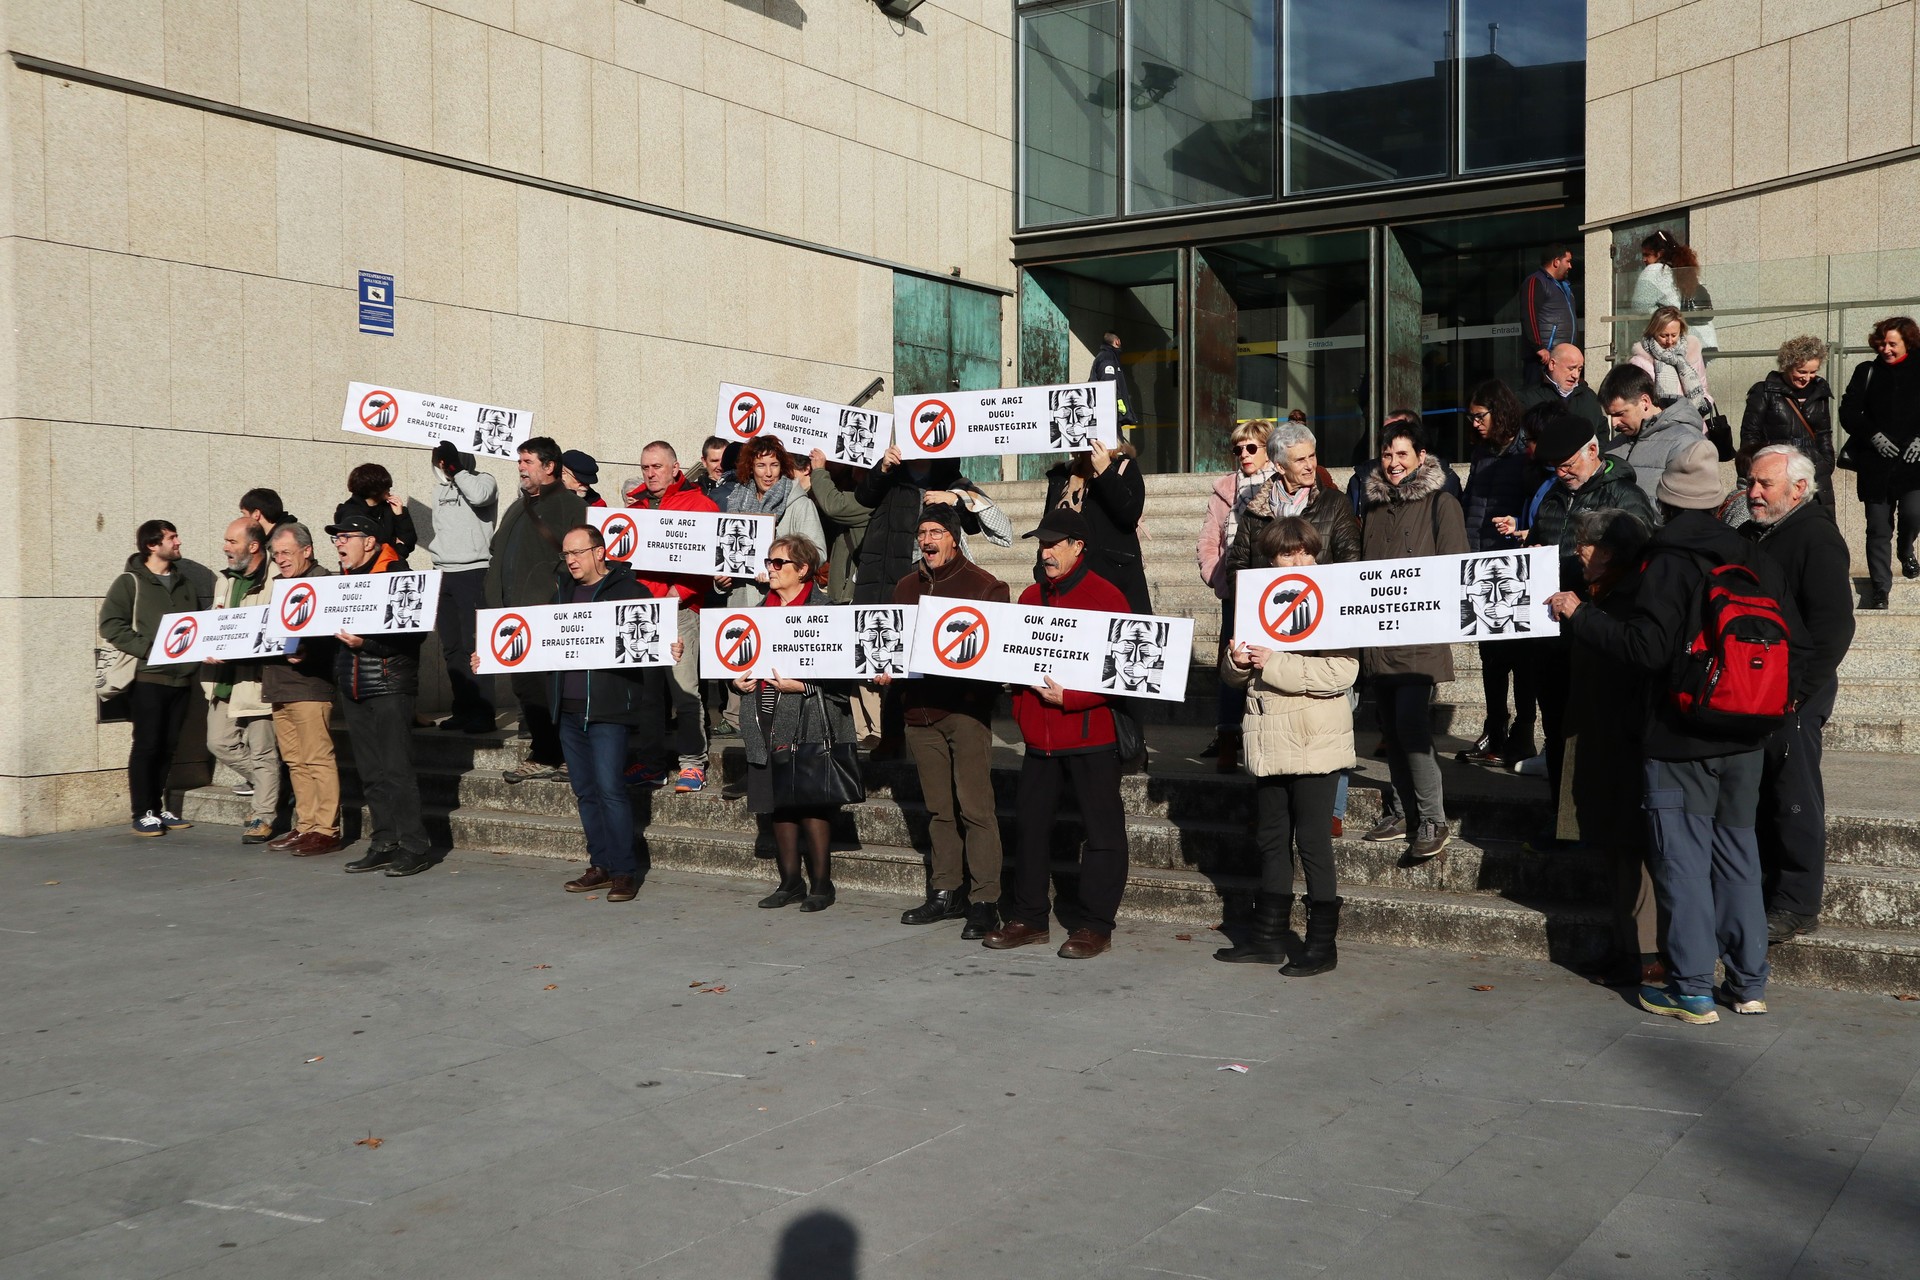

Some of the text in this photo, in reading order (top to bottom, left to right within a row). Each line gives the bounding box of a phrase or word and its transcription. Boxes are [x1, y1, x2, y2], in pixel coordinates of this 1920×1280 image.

[1490, 325, 1520, 335] Entrada
[1307, 340, 1334, 348] Entrada
[421, 400, 458, 412] GUK ARGI
[980, 396, 1023, 407] GUK ARGI
[785, 401, 821, 415] GUK ARGI
[426, 411, 449, 420] DUGU:
[791, 413, 812, 424] DUGU:
[988, 409, 1015, 419] DUGU:
[407, 417, 466, 433] ERRAUSTEGIRIK
[773, 421, 829, 439] ERRAUSTEGIRIK
[967, 421, 1038, 433] ERRAUSTEGIRIK
[427, 431, 441, 439] EZ!
[994, 435, 1010, 445] EZ!
[792, 436, 805, 446] EZ!
[659, 517, 697, 527] GUK ARGI
[665, 529, 688, 539] DUGU:
[647, 540, 707, 552] ERRAUSTEGIRIK
[669, 554, 682, 562] EZ!
[1359, 567, 1422, 581] GUK ARGI
[337, 580, 371, 590] GUK ARGI
[1370, 585, 1408, 598] DUGU:
[341, 593, 363, 601] DUGU:
[323, 604, 378, 614] ERRAUSTEGIRIK
[1339, 600, 1441, 616] ERRAUSTEGIRIK
[231, 612, 248, 620] ARGI
[342, 616, 354, 625] EZ!
[553, 610, 593, 621] GUK ARGI
[785, 614, 829, 625] GUK ARGI
[1024, 614, 1078, 629] GUK ARGI
[1378, 619, 1400, 631] EZ!
[219, 623, 238, 631] DUGU:
[560, 624, 584, 634] DUGU:
[202, 632, 250, 642] ERRAUSTEGIRIK
[793, 629, 820, 638] DUGU:
[1031, 630, 1064, 643] DUGU:
[541, 636, 605, 647] ERRAUSTEGIRIK
[772, 643, 843, 653] ERRAUSTEGIRIK
[1002, 643, 1090, 662] ERRAUSTEGIRIK
[565, 650, 579, 659] EZ!
[799, 657, 814, 667] EZ!
[1033, 662, 1053, 674] EZ!
